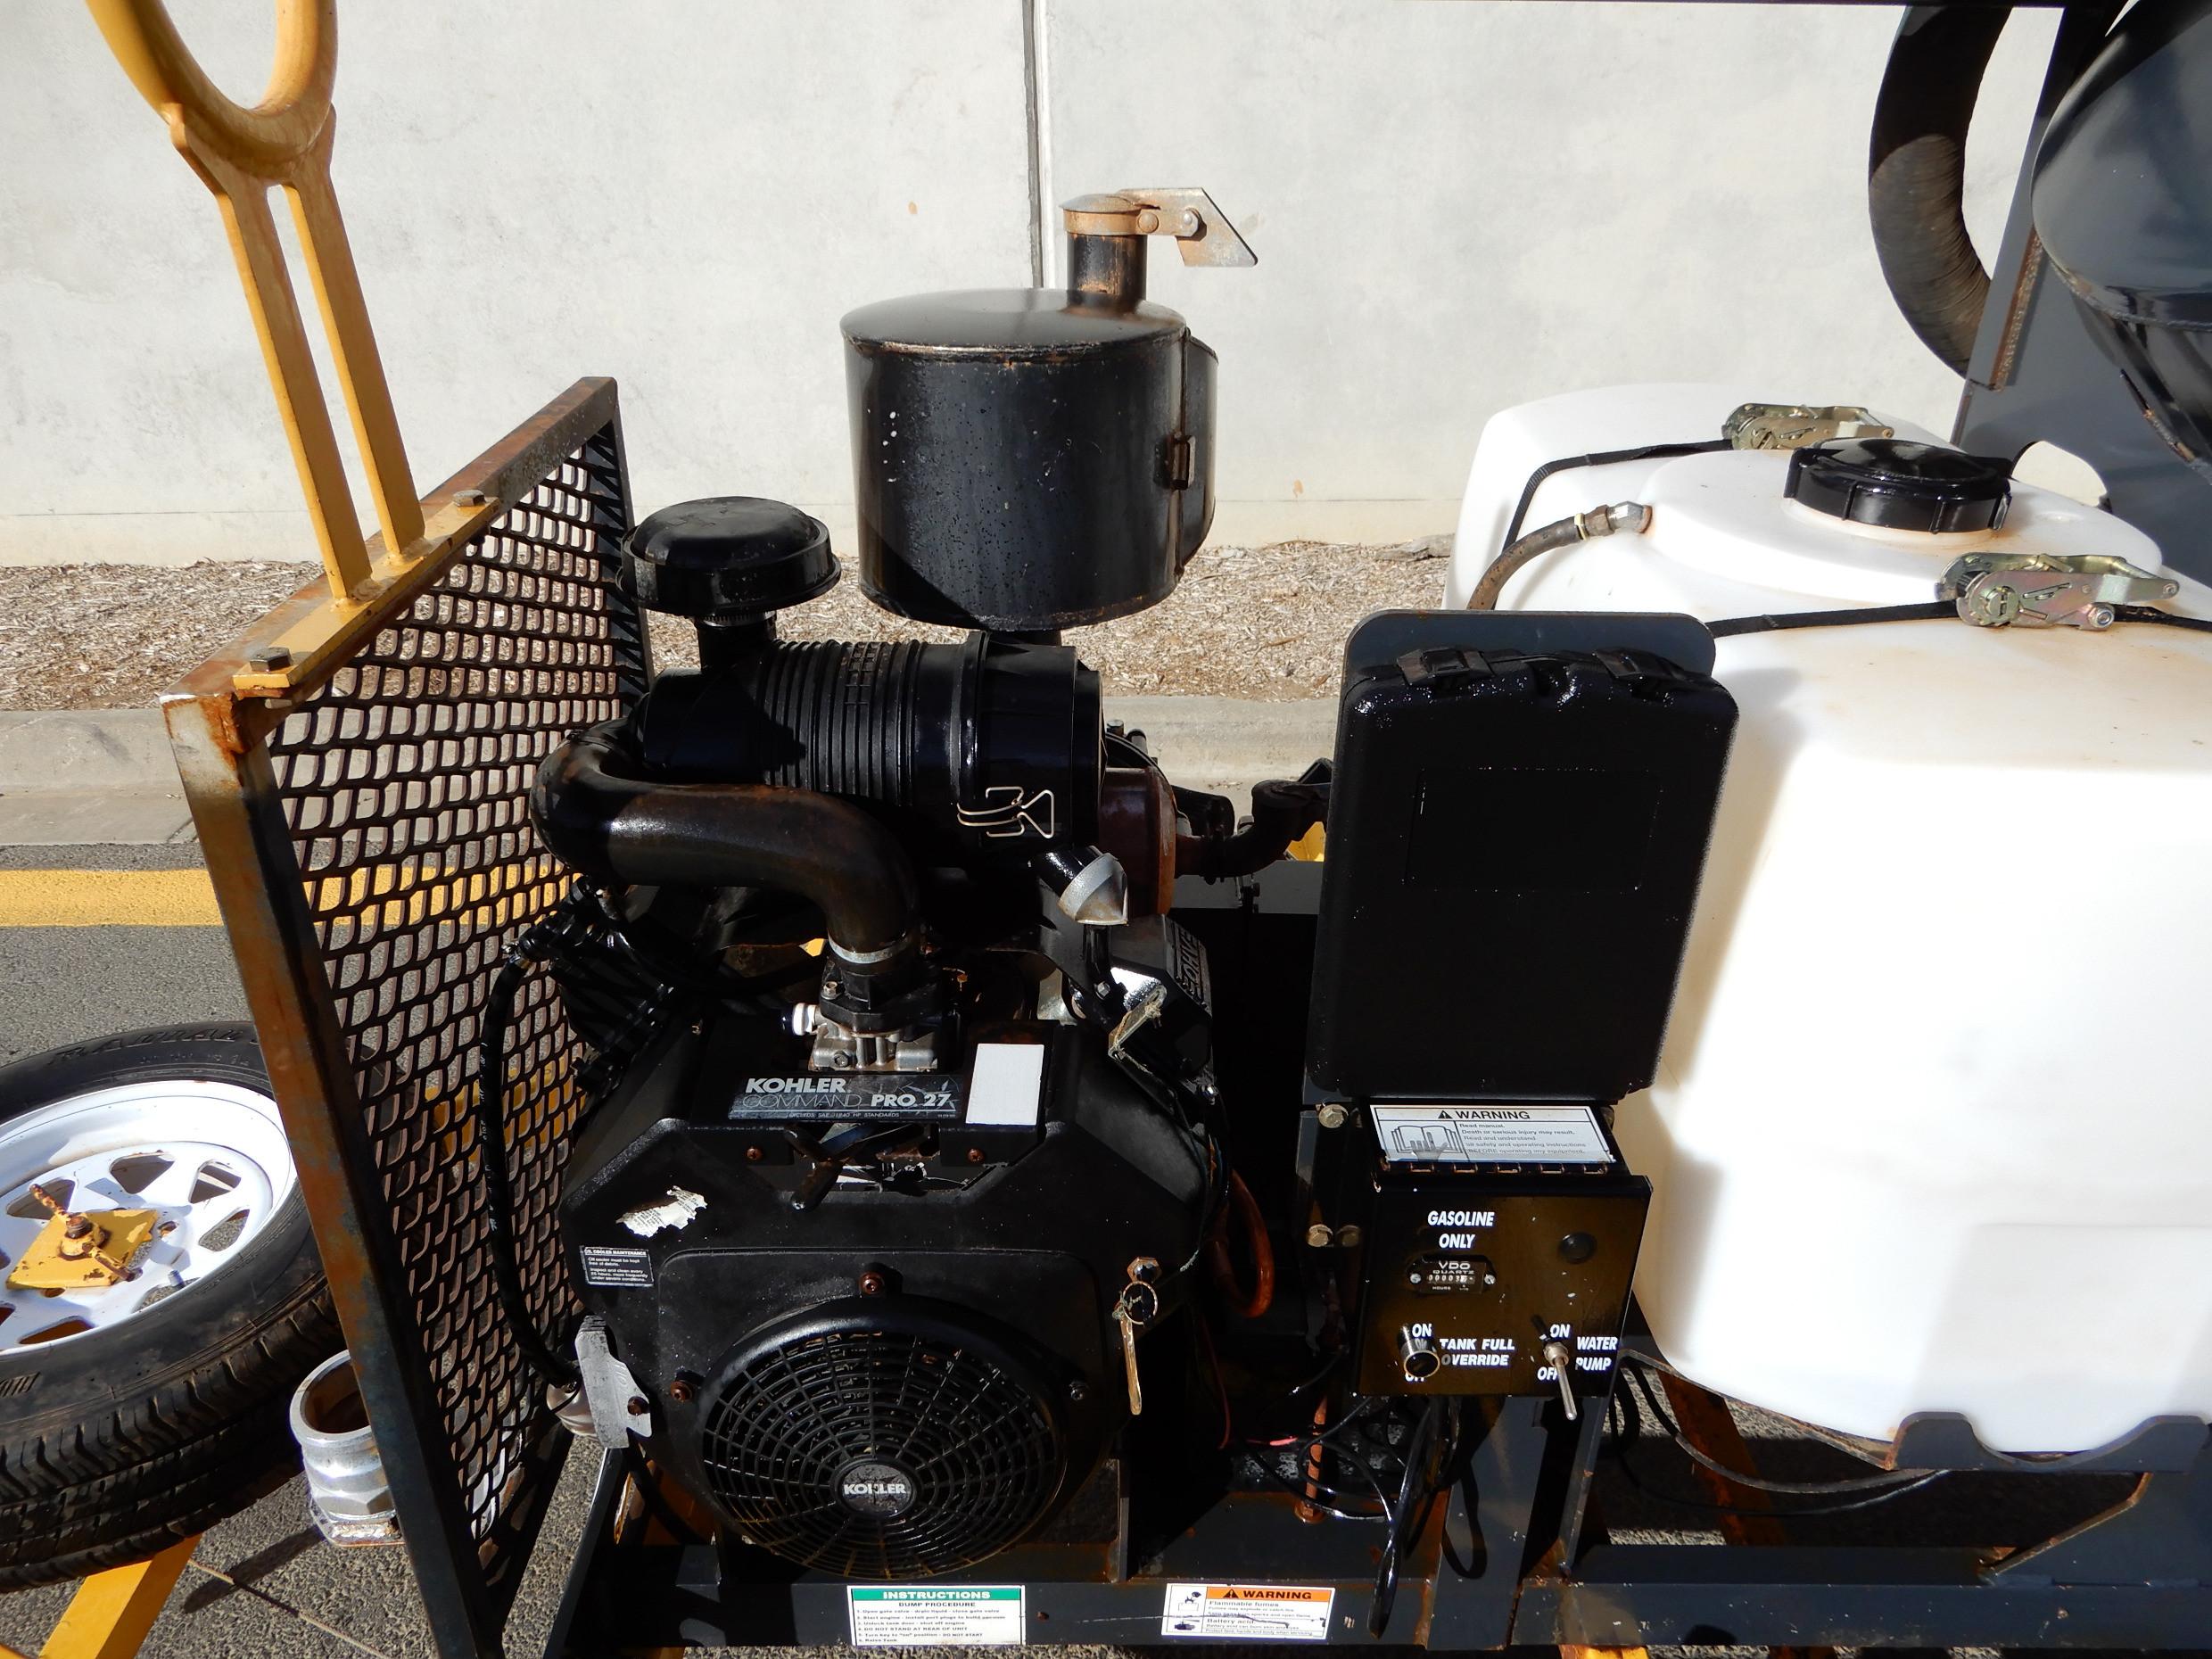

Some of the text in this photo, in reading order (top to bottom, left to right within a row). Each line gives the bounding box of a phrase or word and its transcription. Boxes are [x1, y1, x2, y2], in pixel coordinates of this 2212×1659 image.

[745, 1077, 846, 1093] KOHLER
[743, 1093, 953, 1107] COMMAND PRO 27
[1455, 1110, 1531, 1120] WARNING
[1428, 1210, 1494, 1226] GASOLINE
[1439, 1233, 1475, 1248] ONLY
[1438, 1260, 1470, 1269] VDO
[1412, 1324, 1432, 1337] ON
[1550, 1324, 1570, 1338] ON
[1439, 1339, 1515, 1350] TANK FULL
[1577, 1337, 1617, 1350] WATER
[1441, 1354, 1509, 1366] OVERRIDE
[1575, 1357, 1611, 1370] PUMP
[844, 1483, 906, 1494] KOHLER
[1243, 1591, 1312, 1599] WARNING
